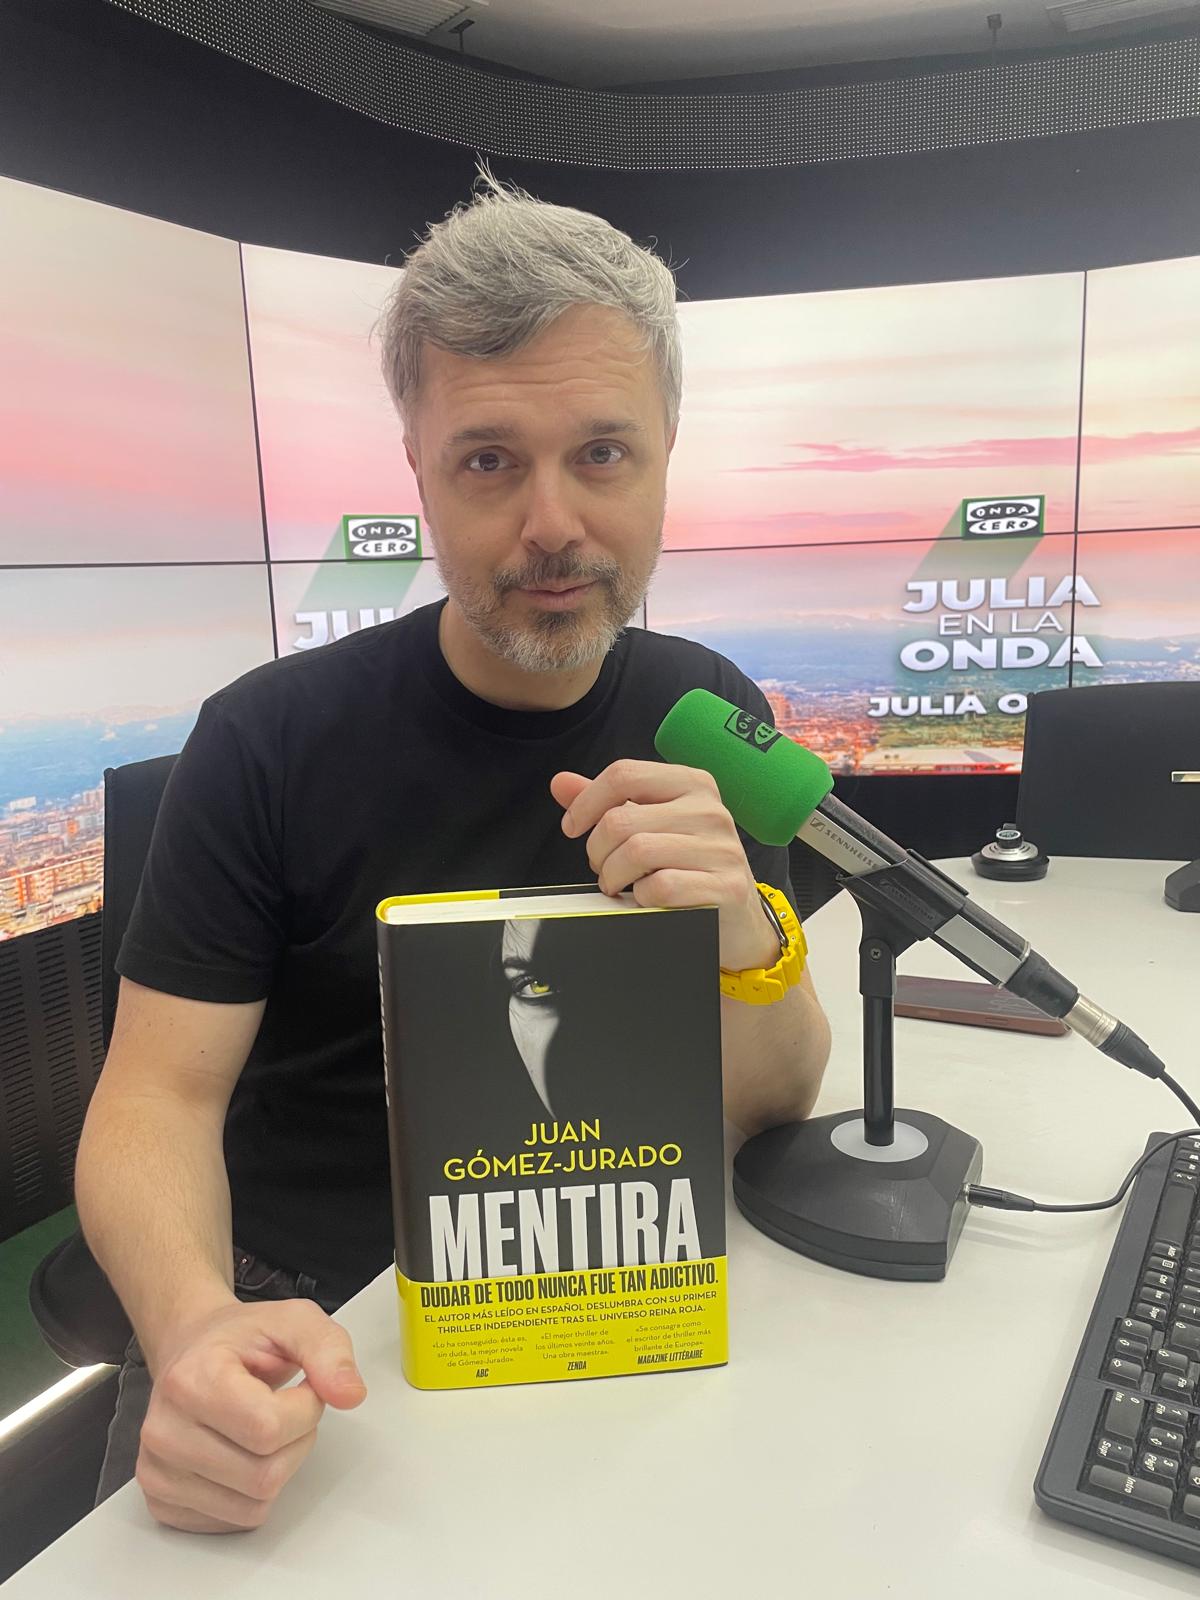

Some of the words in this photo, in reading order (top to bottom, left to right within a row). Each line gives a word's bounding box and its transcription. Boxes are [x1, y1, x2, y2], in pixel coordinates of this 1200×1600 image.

[976, 505, 1030, 517] ONDA
[357, 526, 408, 536] ONDA
[979, 520, 1029, 531] CERO
[362, 543, 408, 553] CERO
[903, 575, 1101, 613] JULIA
[939, 612, 994, 636] EN
[1011, 610, 1064, 633] LA
[900, 635, 1104, 671] ONDA
[867, 694, 987, 718] JULIA
[524, 1118, 601, 1146] JUAN
[443, 1143, 682, 1181] GÓMEZ-JURADO
[429, 1178, 702, 1282] MENTIRA
[421, 1285, 470, 1308] DUDAR
[474, 1282, 493, 1305] DE
[496, 1279, 534, 1303] TODO
[538, 1274, 587, 1300] NUNCA
[590, 1272, 615, 1295] FUE
[619, 1269, 646, 1293] TAN
[650, 1263, 719, 1290] ADICTIVO.
[425, 1314, 435, 1323] EL
[438, 1312, 470, 1323] AUTOR
[473, 1308, 493, 1320] MÁS
[496, 1307, 523, 1318] LEÍDO
[526, 1305, 538, 1314] EN
[541, 1302, 583, 1314] ESPAÑOL
[586, 1299, 643, 1311] DESLUMBRA
[645, 1296, 667, 1306] CON
[669, 1294, 681, 1303] SU
[683, 1291, 717, 1301] PRIMER
[438, 1323, 481, 1334] THRILLER
[484, 1316, 558, 1330] INDEPENDIENTE
[561, 1315, 584, 1325] TRAS
[587, 1314, 597, 1322] EL
[600, 1310, 647, 1322] UNIVERSO
[649, 1307, 676, 1317] REINA
[679, 1305, 705, 1314] ROJA.
[649, 1322, 680, 1332] consagra
[682, 1320, 702, 1328] como
[553, 1331, 573, 1342] mejor
[574, 1328, 598, 1338] thriller
[600, 1328, 609, 1336] de
[626, 1335, 633, 1343] el
[634, 1333, 661, 1343] escritor
[662, 1332, 672, 1340] de
[673, 1329, 696, 1339] thriller
[697, 1328, 711, 1336] más
[446, 1340, 455, 1348] ha
[535, 1343, 546, 1351] los
[574, 1339, 596, 1348] veinte
[634, 1343, 662, 1352] brillante
[663, 1342, 673, 1350] de
[437, 1351, 448, 1359] sin
[478, 1347, 499, 1358] mejor
[500, 1345, 524, 1353] novela
[543, 1352, 557, 1360] Una
[558, 1350, 575, 1359] obra
[637, 1352, 668, 1365] MAGAZINE
[669, 1349, 704, 1362] LITTÉRAIRE
[447, 1359, 457, 1367] de
[567, 1361, 587, 1371] ZENDA
[475, 1368, 489, 1378] ABC
[1166, 1432, 1177, 1440] 2
[1099, 1440, 1112, 1457] Supr
[1124, 1476, 1137, 1494] Intro
